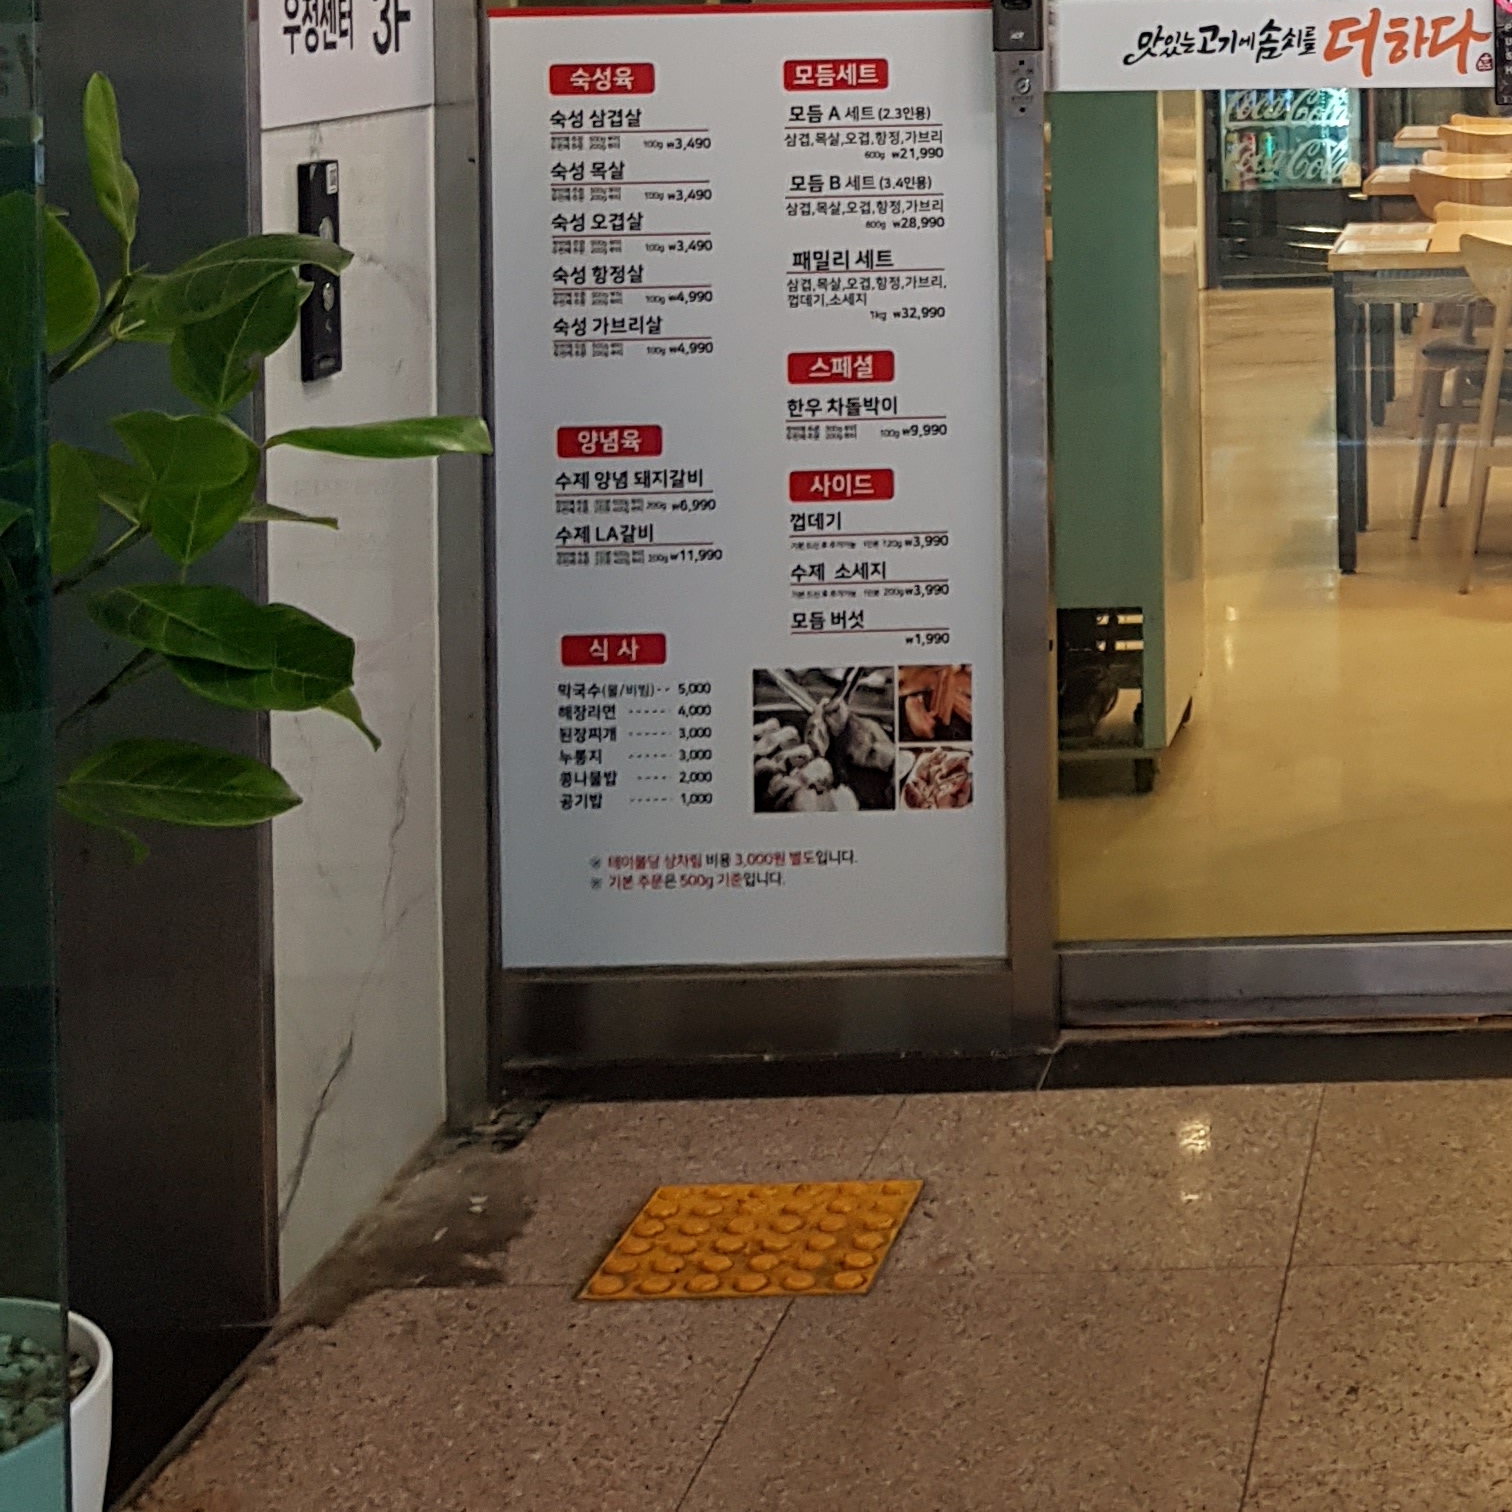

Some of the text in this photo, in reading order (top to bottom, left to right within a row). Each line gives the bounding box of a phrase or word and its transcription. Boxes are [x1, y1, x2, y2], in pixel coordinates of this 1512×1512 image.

[1323, 7, 1492, 77] 더하다
[570, 66, 635, 91] 숙성육
[793, 63, 878, 87] 모듬세트
[550, 108, 642, 128] 숙성 삼겹살
[788, 105, 823, 123] 모듬
[828, 106, 841, 121] A
[845, 105, 875, 121] 세트
[551, 160, 625, 181] 숙성 목살
[789, 175, 824, 193] 모듬
[829, 175, 841, 189] B
[845, 175, 876, 191] 세트
[551, 211, 643, 232] 숙성 오겹살
[792, 249, 894, 271] 패밀리 세트
[552, 264, 644, 284] 숙성 항정살
[553, 315, 663, 336] 숙성 가브리살
[809, 354, 874, 379] 스페셜
[787, 396, 898, 417] 한우 차돌박이
[578, 429, 642, 454] 양념육
[555, 469, 704, 490] 수제 양념 돼지갈비
[810, 473, 874, 497] 사이드
[790, 511, 842, 531] 껍데기
[555, 523, 654, 544] 수제 LA갈비
[791, 561, 886, 582] 수제 소세지
[791, 609, 865, 630] 모듬 버섯
[678, 682, 712, 696] 5,000
[678, 704, 712, 718] 4,000
[679, 727, 712, 740] 3,000
[679, 749, 712, 763] 3,000
[679, 771, 713, 784] 2,000
[560, 793, 713, 810] 공기밥 1,000
[706, 852, 730, 868] 비용
[609, 874, 633, 890] 기본
[680, 873, 714, 889] 500g
